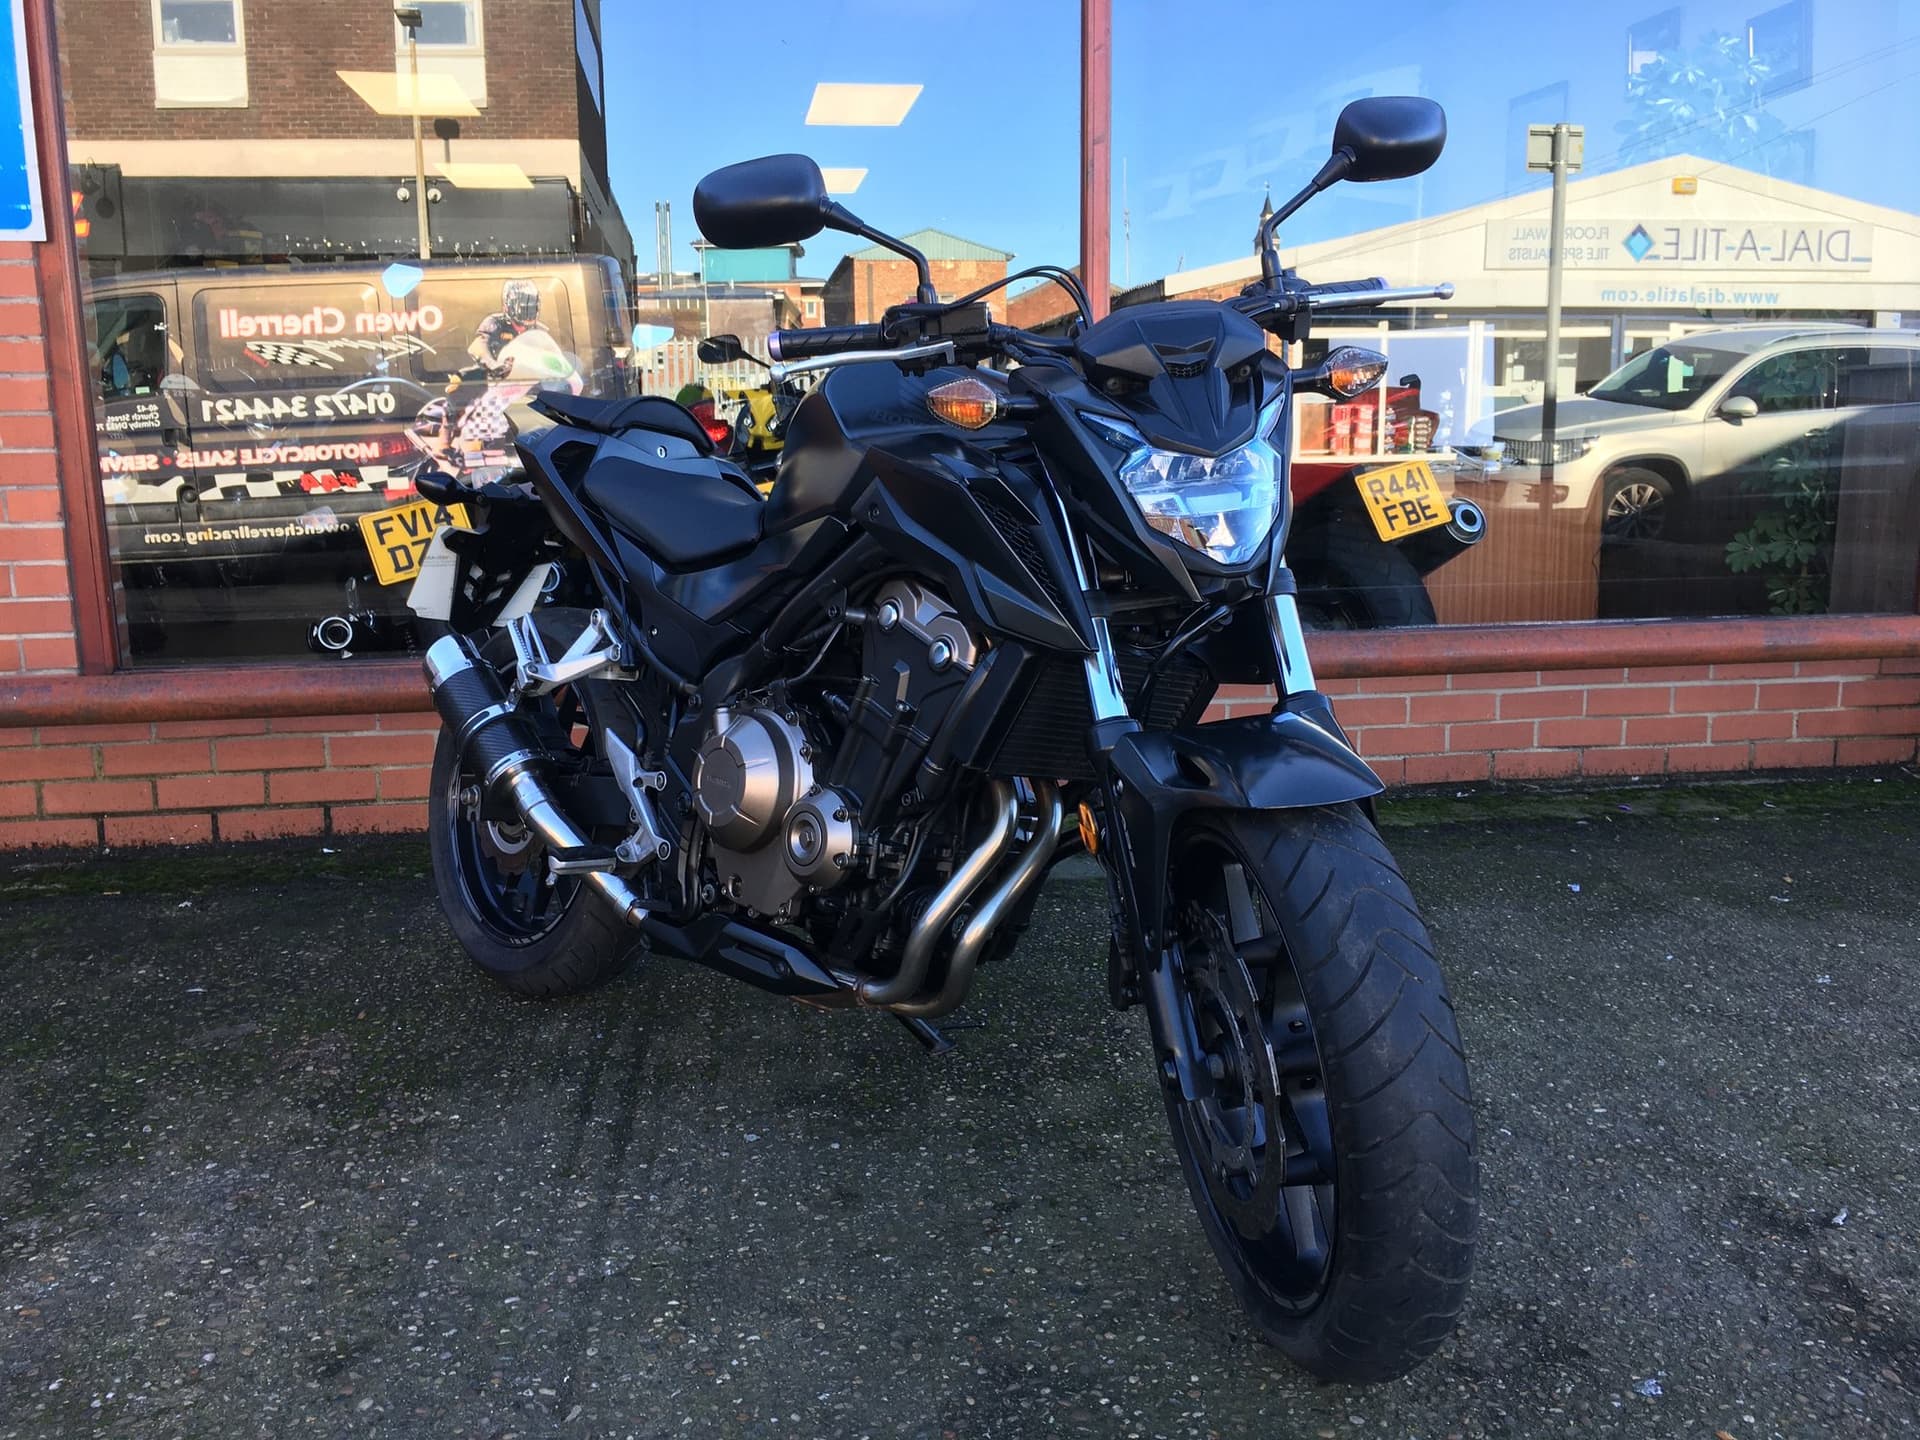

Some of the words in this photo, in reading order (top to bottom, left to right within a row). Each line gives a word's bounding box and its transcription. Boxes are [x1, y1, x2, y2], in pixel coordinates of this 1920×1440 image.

[1366, 466, 1430, 505] R441
[372, 505, 455, 546] FV14
[1382, 495, 1440, 532] FBE
[387, 537, 432, 574] DZ
